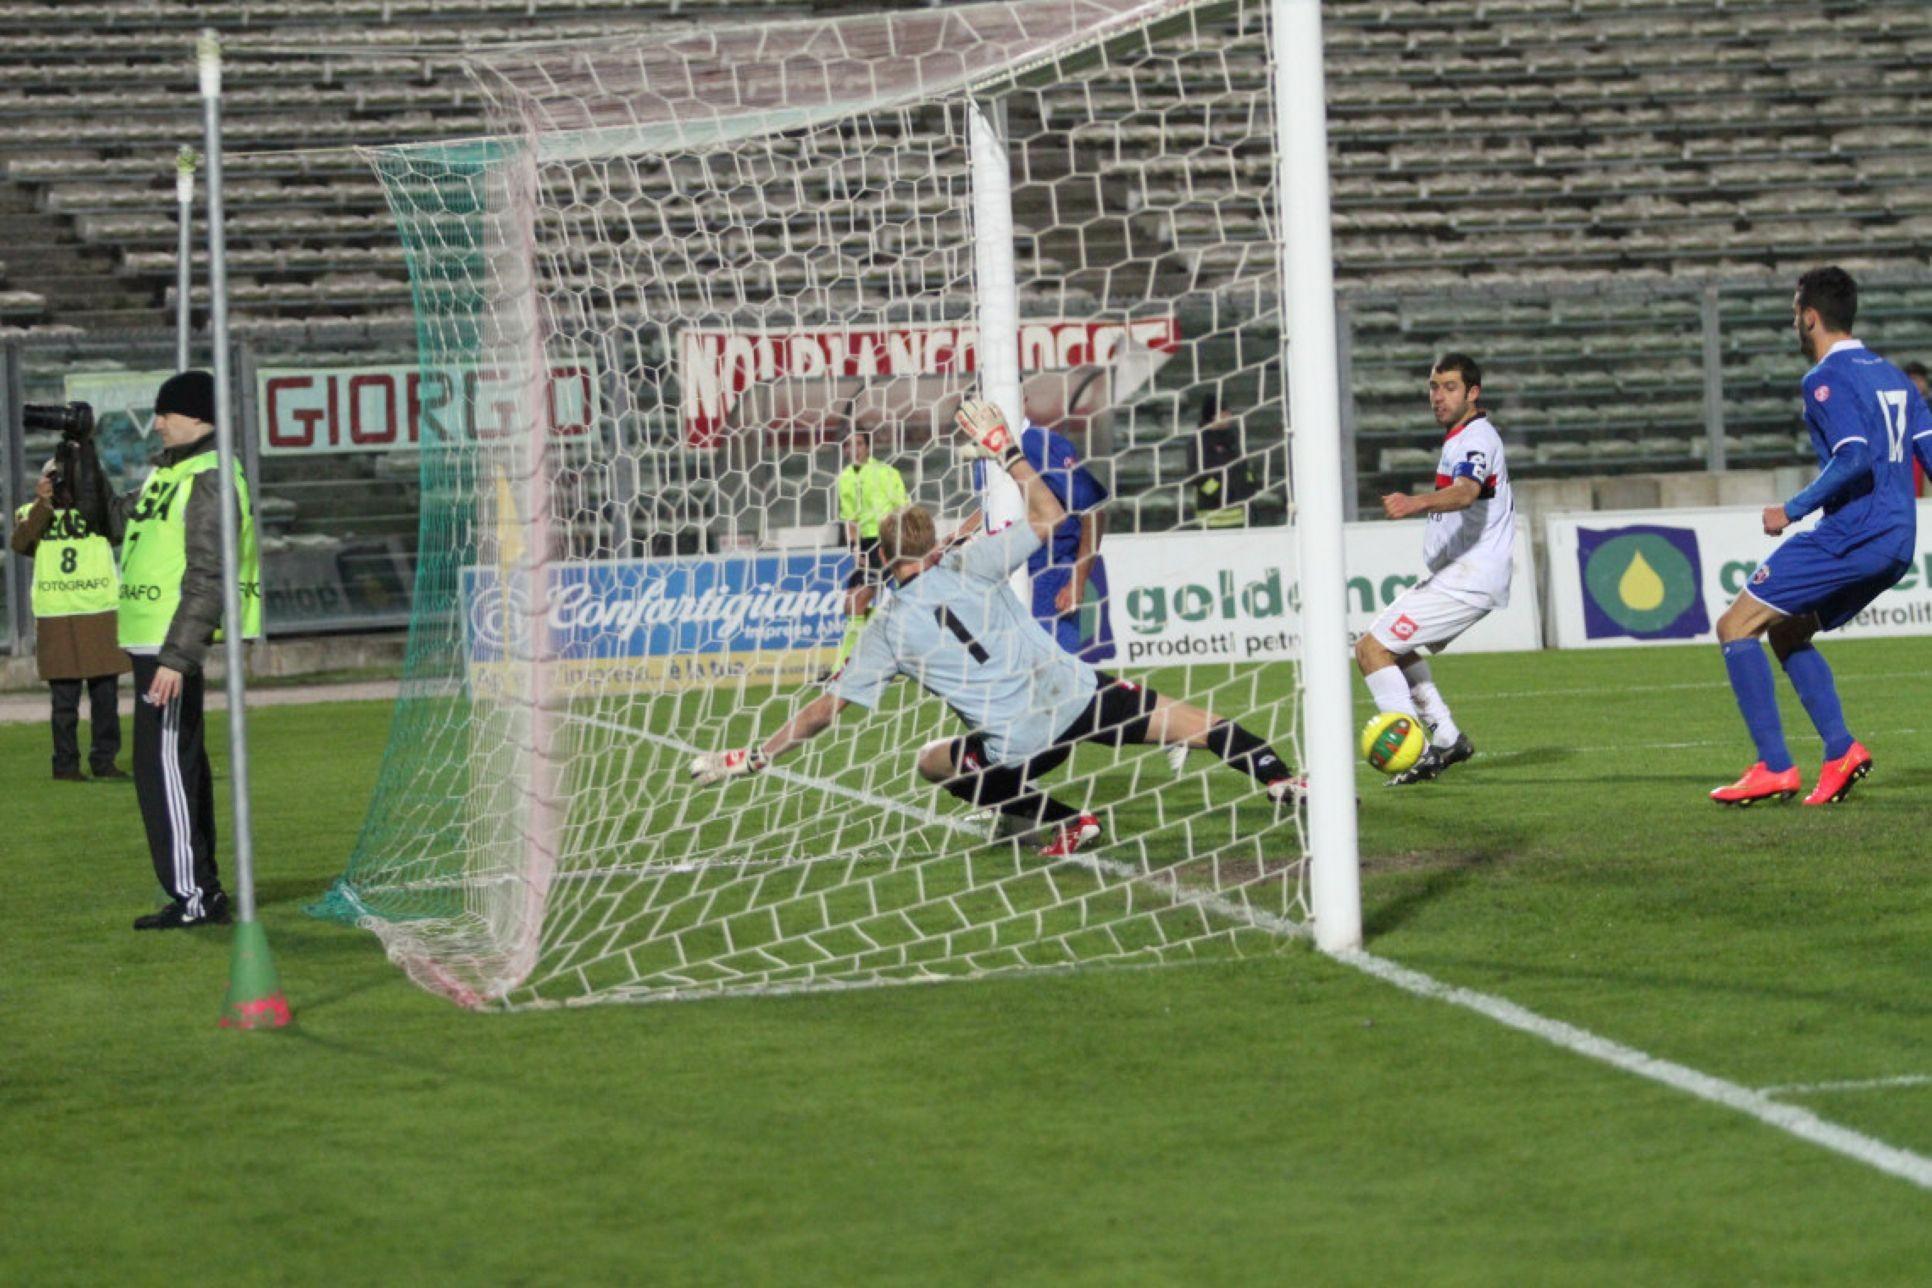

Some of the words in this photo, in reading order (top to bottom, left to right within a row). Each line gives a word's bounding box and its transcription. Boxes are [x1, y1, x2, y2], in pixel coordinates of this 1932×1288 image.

[1876, 389, 1908, 463] 17
[60, 547, 77, 574] 8
[933, 605, 990, 665] 1
